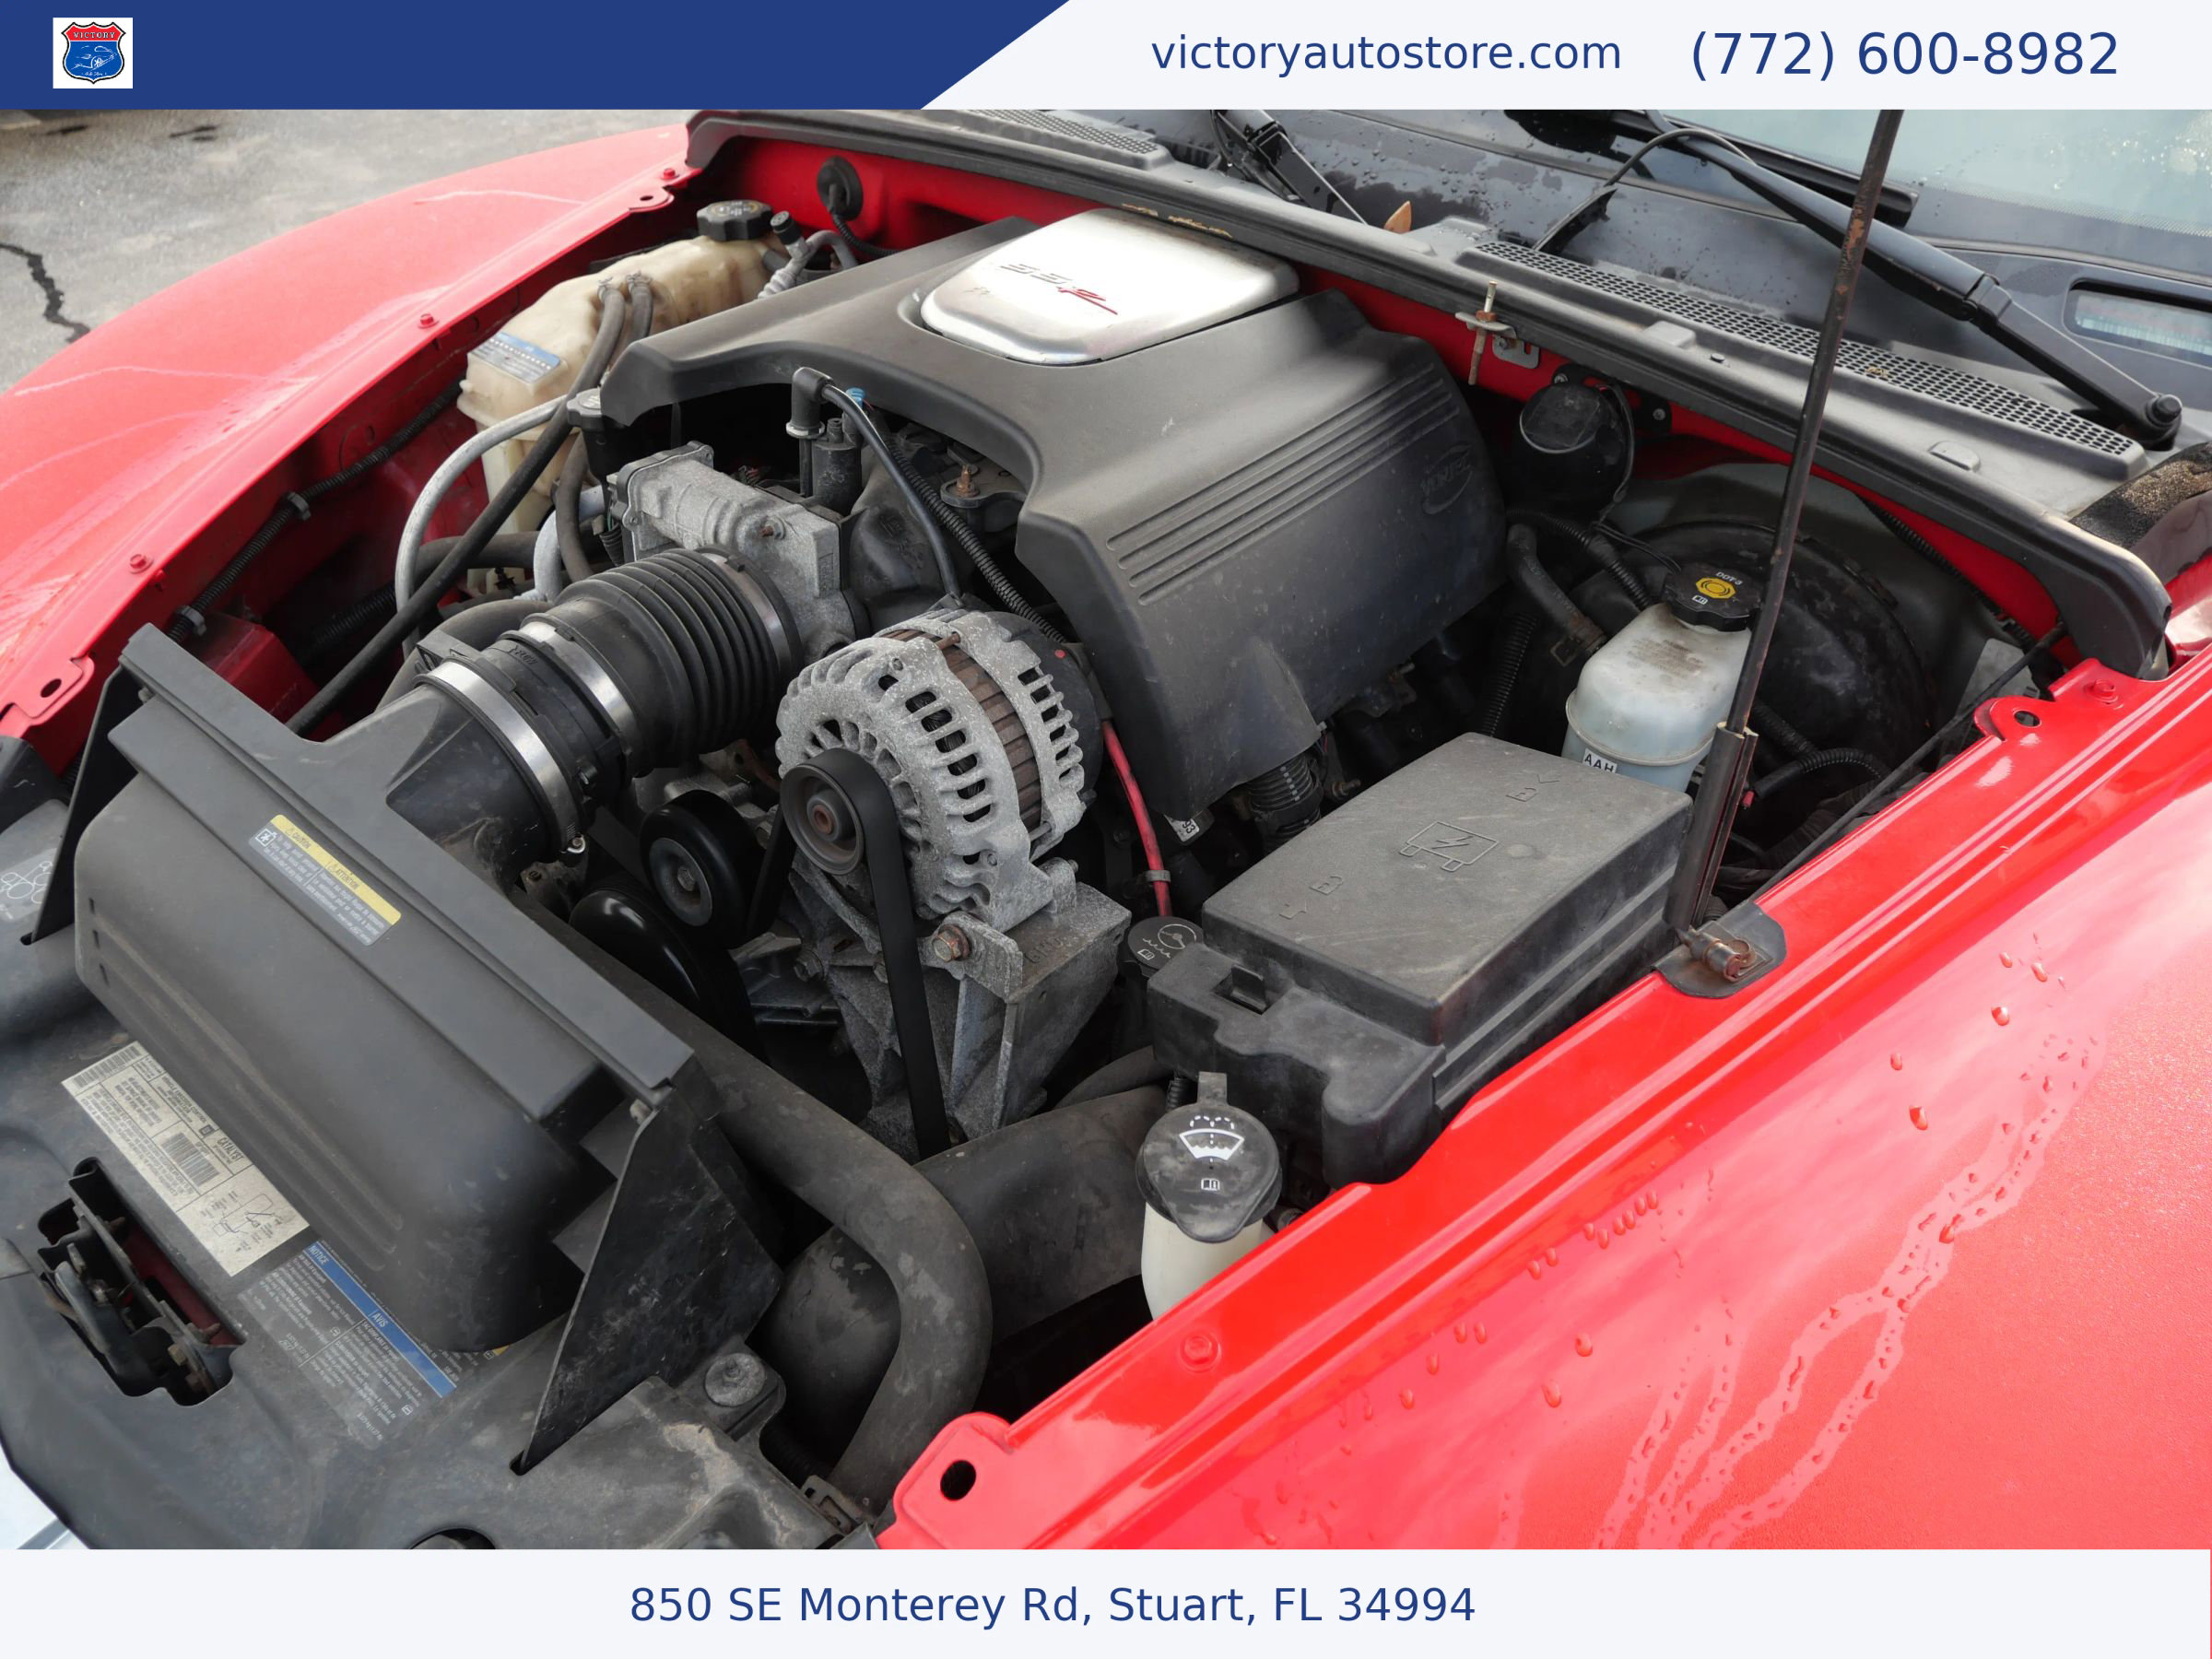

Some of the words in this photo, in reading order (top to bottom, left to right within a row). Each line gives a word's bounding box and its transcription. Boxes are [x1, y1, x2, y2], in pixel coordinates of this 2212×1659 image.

[1715, 571, 1735, 582] DOT
[1583, 753, 1615, 772] AAH
[217, 1136, 244, 1161] CATALYST
[308, 1245, 330, 1265] NOTICE
[371, 1312, 389, 1328] AVIS
